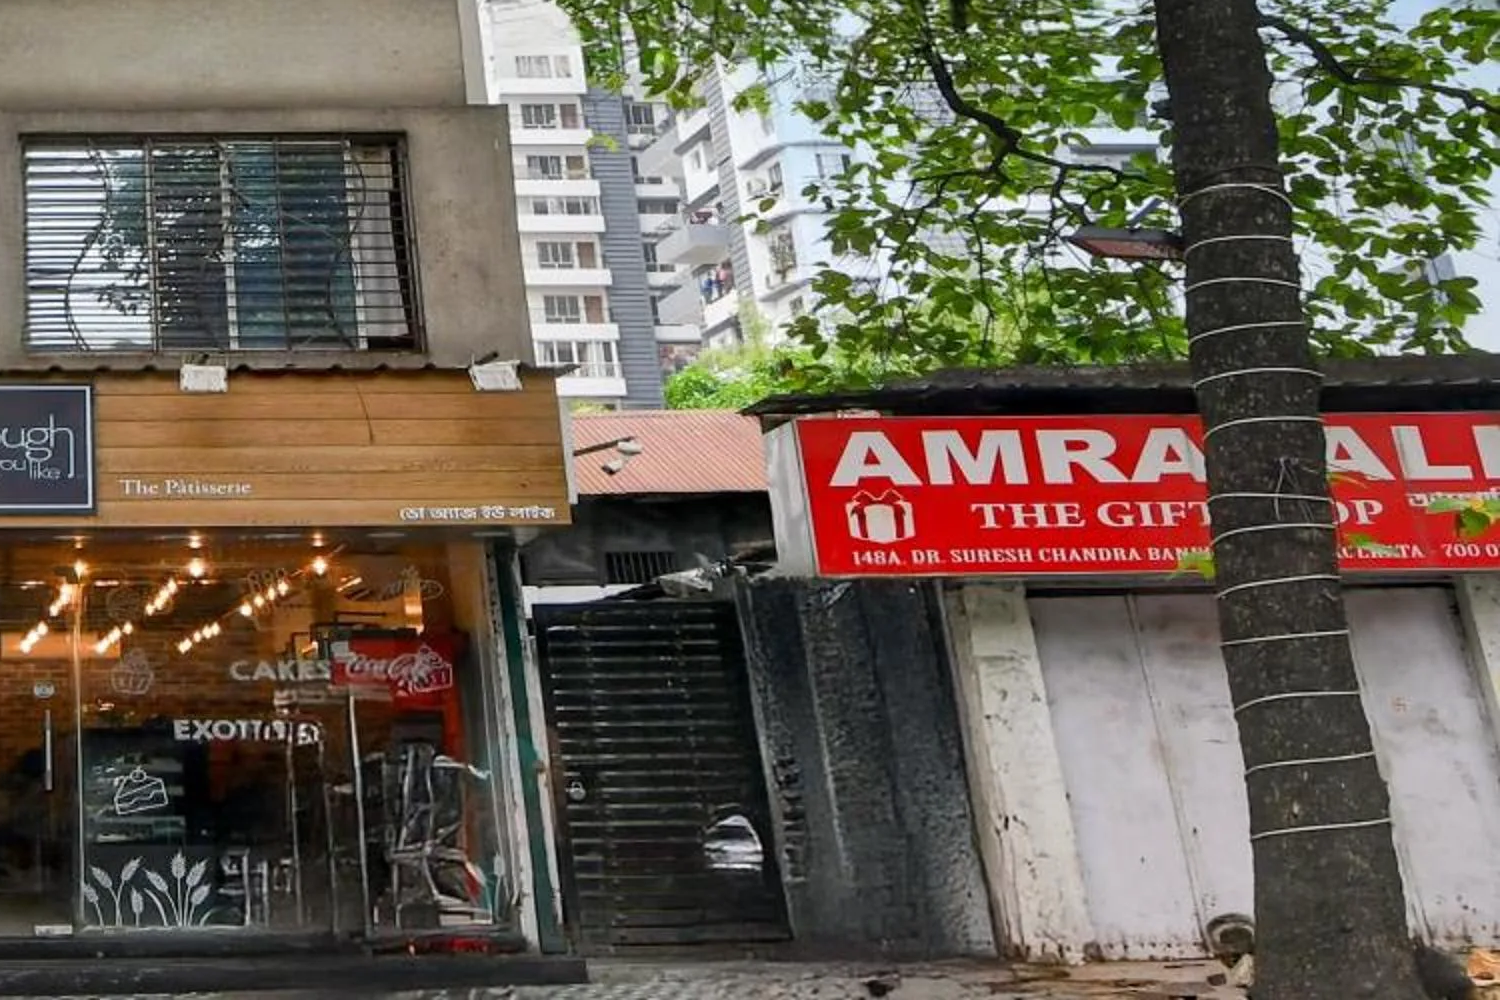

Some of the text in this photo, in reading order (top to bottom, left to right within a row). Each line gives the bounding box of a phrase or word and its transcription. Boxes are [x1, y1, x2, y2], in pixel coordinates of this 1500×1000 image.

[29, 458, 62, 481] like
[119, 479, 159, 496] The
[971, 500, 1212, 529] THE GIFT
[950, 548, 1032, 563] SURESH
[1038, 547, 1141, 562] CHANDRA
[1441, 543, 1481, 559] 700
[229, 660, 332, 681] CAKES
